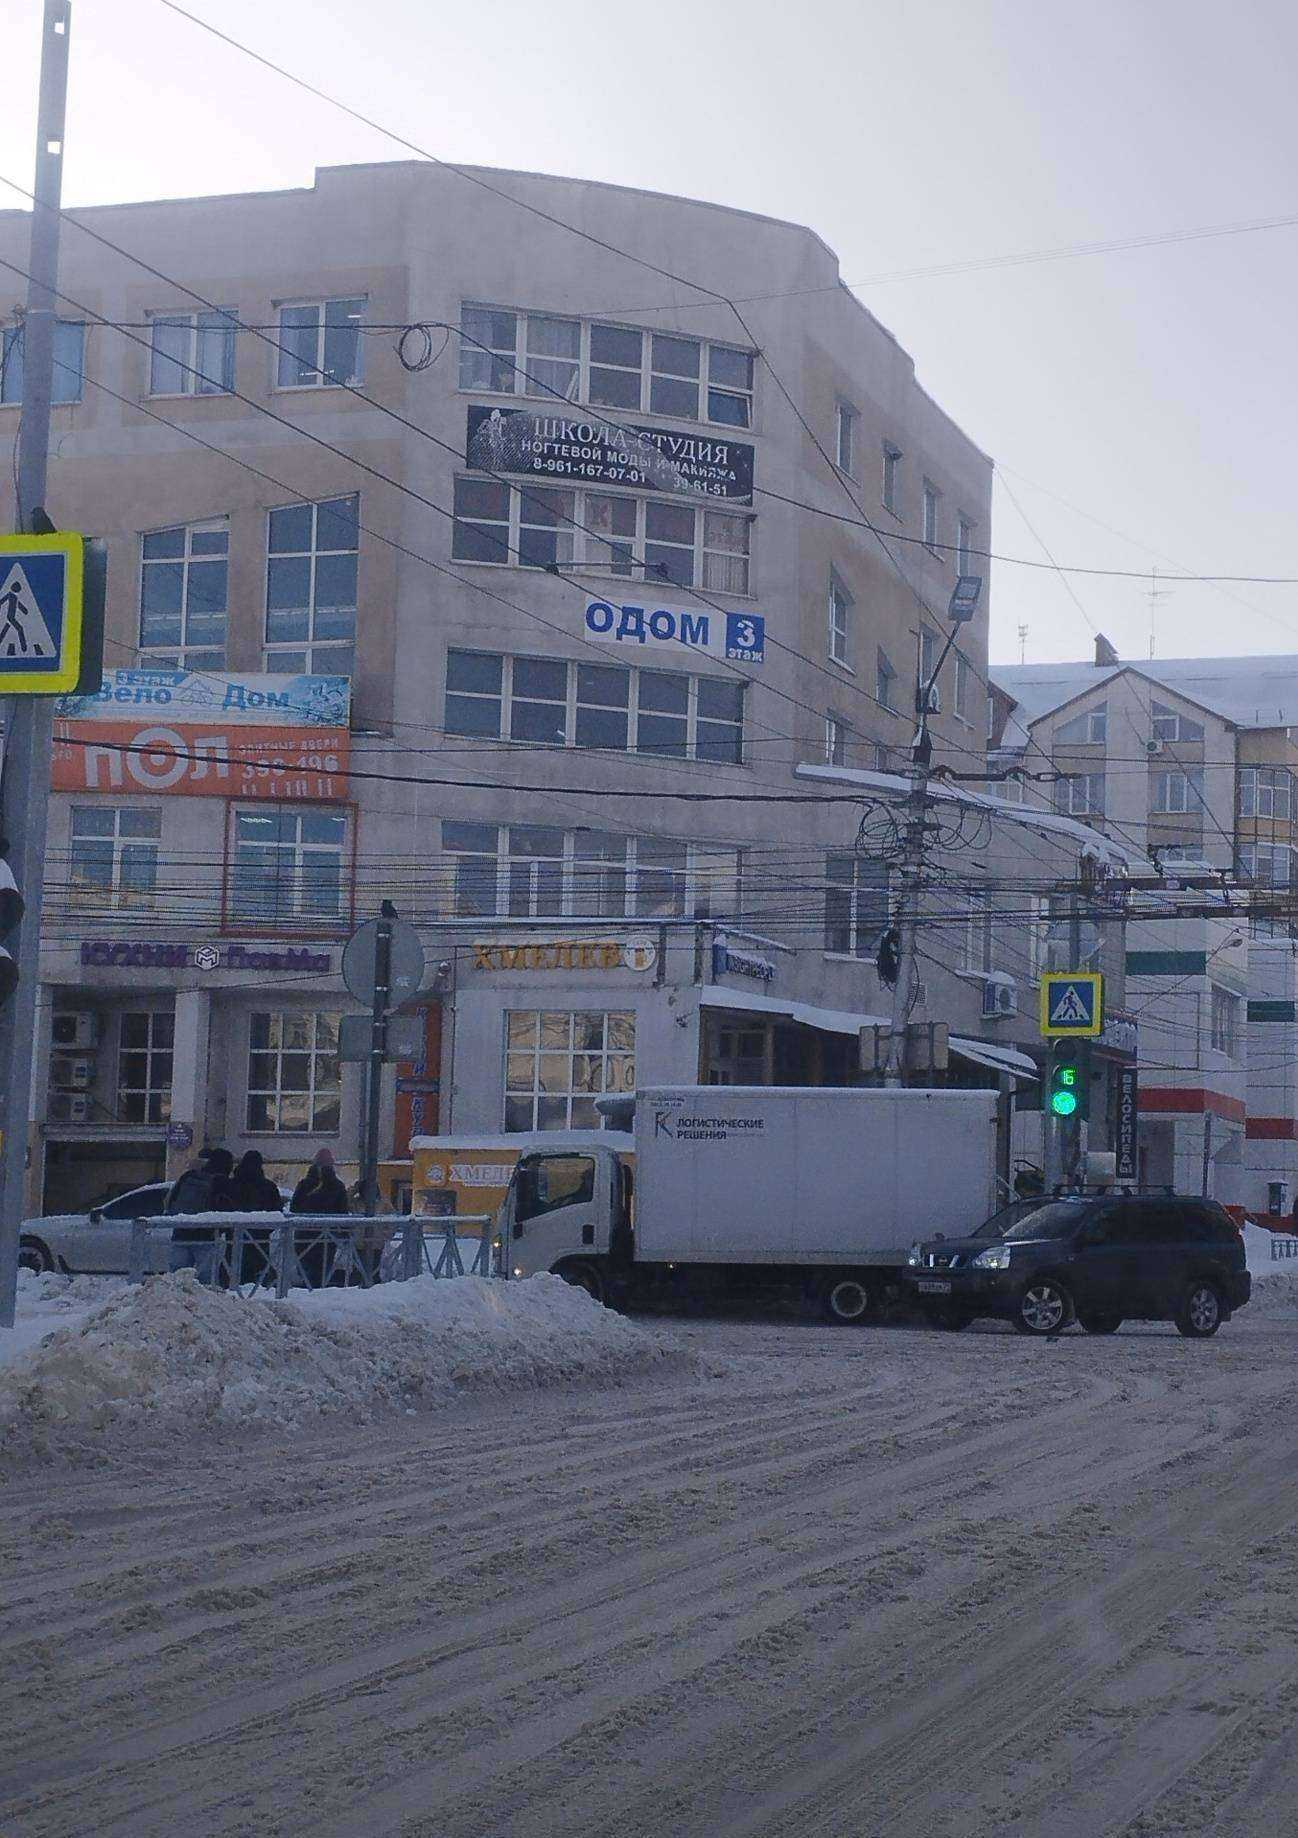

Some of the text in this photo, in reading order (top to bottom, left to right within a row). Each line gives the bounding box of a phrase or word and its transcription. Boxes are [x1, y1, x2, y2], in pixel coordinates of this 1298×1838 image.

[521, 439, 602, 460] НОГТЕВОЙ
[607, 450, 650, 468] МОДЫ
[534, 417, 728, 464] ШКОЛА-СТУДИЯ
[533, 457, 646, 482] 8-961-167-07-01
[585, 602, 710, 645] ОДОМ
[736, 619, 756, 647] 3
[677, 1118, 764, 1129] ЛОГИСТИЧЕСКИЕ
[677, 1130, 727, 1140] РЕШЕНИЯ
[1119, 1073, 1134, 1175] ВЕЛОСИПЕДЫ
